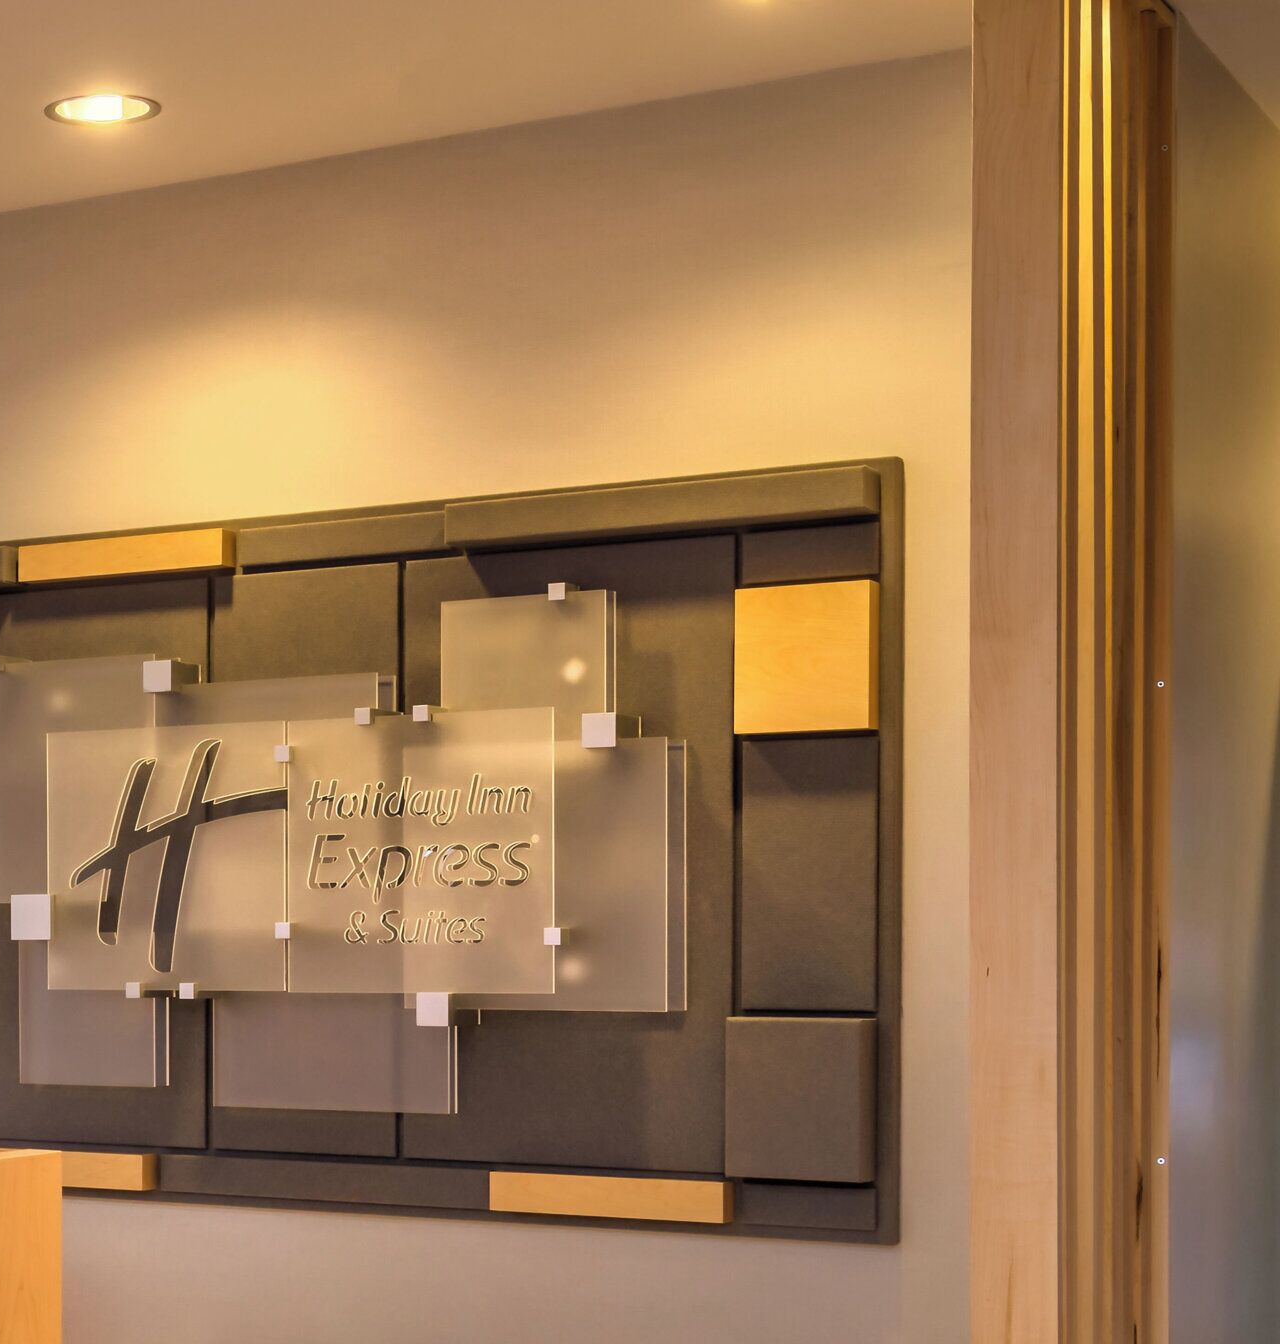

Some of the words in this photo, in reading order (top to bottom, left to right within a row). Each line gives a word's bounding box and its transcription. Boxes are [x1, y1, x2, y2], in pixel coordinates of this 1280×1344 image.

[306, 776, 462, 827] Holiday
[466, 773, 533, 816] Inn
[307, 833, 532, 905] Express
[344, 910, 368, 945] &
[376, 909, 487, 945] Suites
